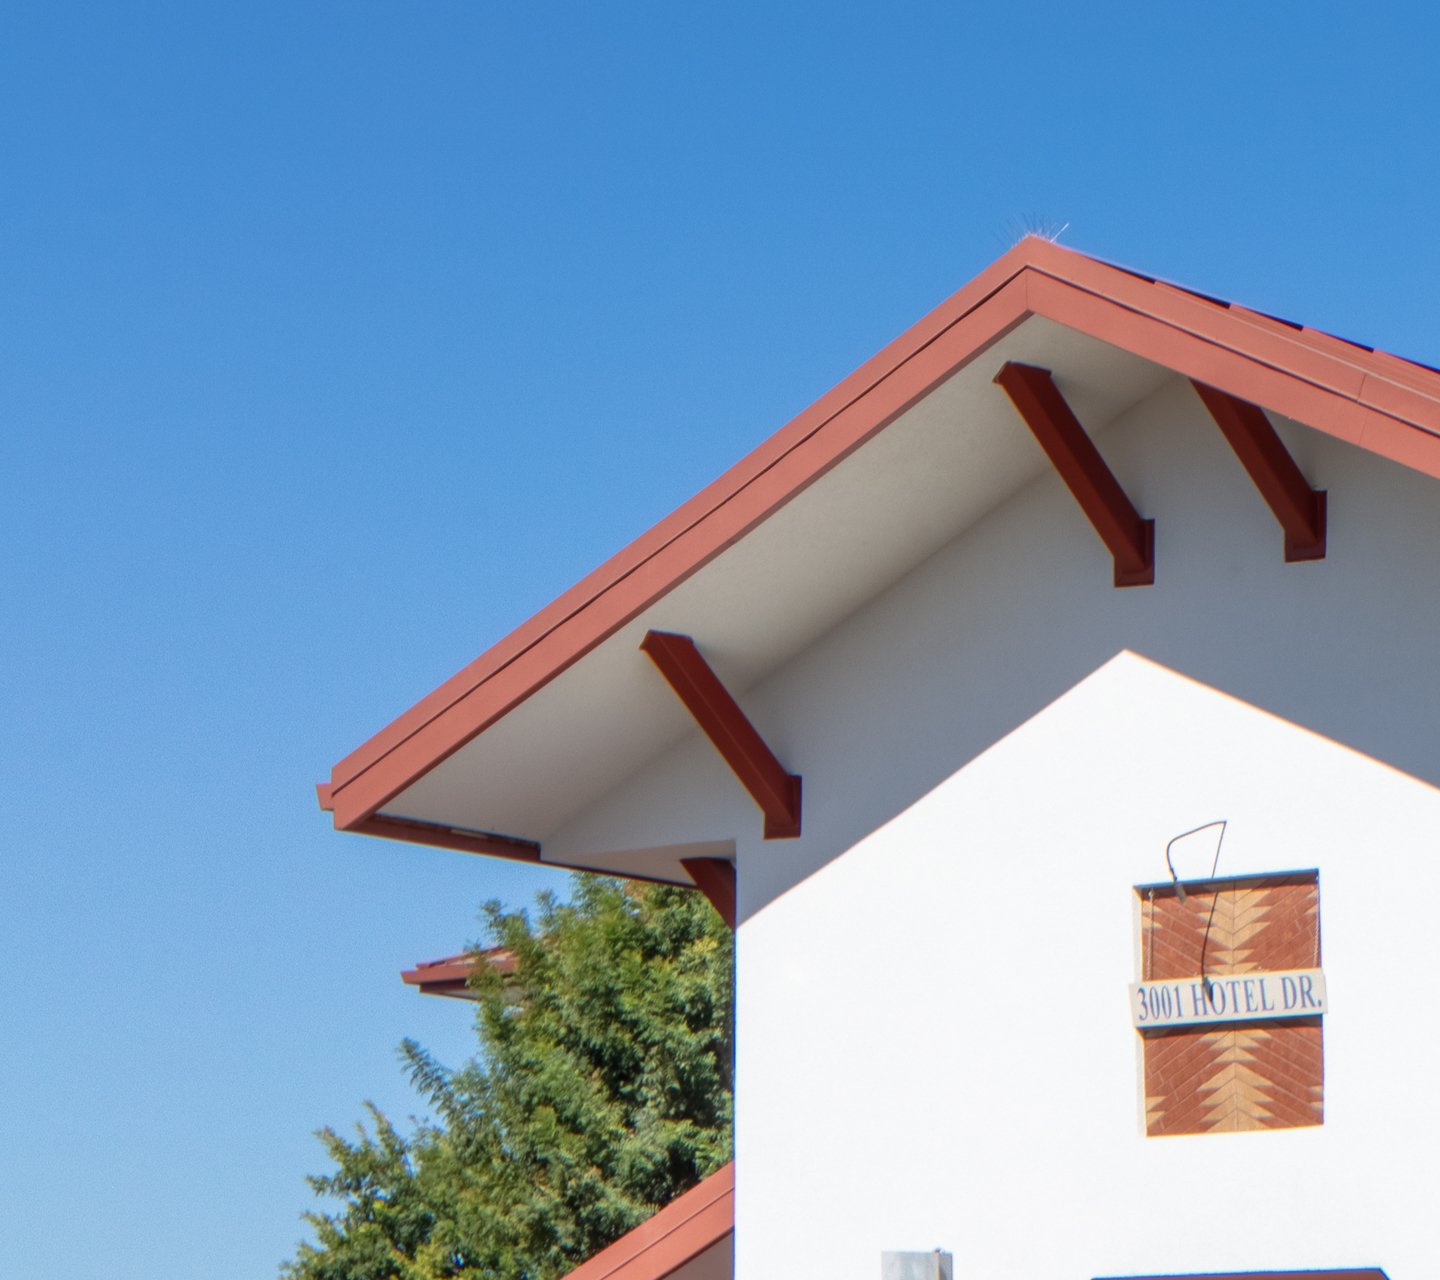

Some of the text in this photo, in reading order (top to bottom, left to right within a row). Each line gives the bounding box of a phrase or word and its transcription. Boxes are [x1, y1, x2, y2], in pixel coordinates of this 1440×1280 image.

[1137, 974, 1322, 1021] 3001 HOTEL DR.
